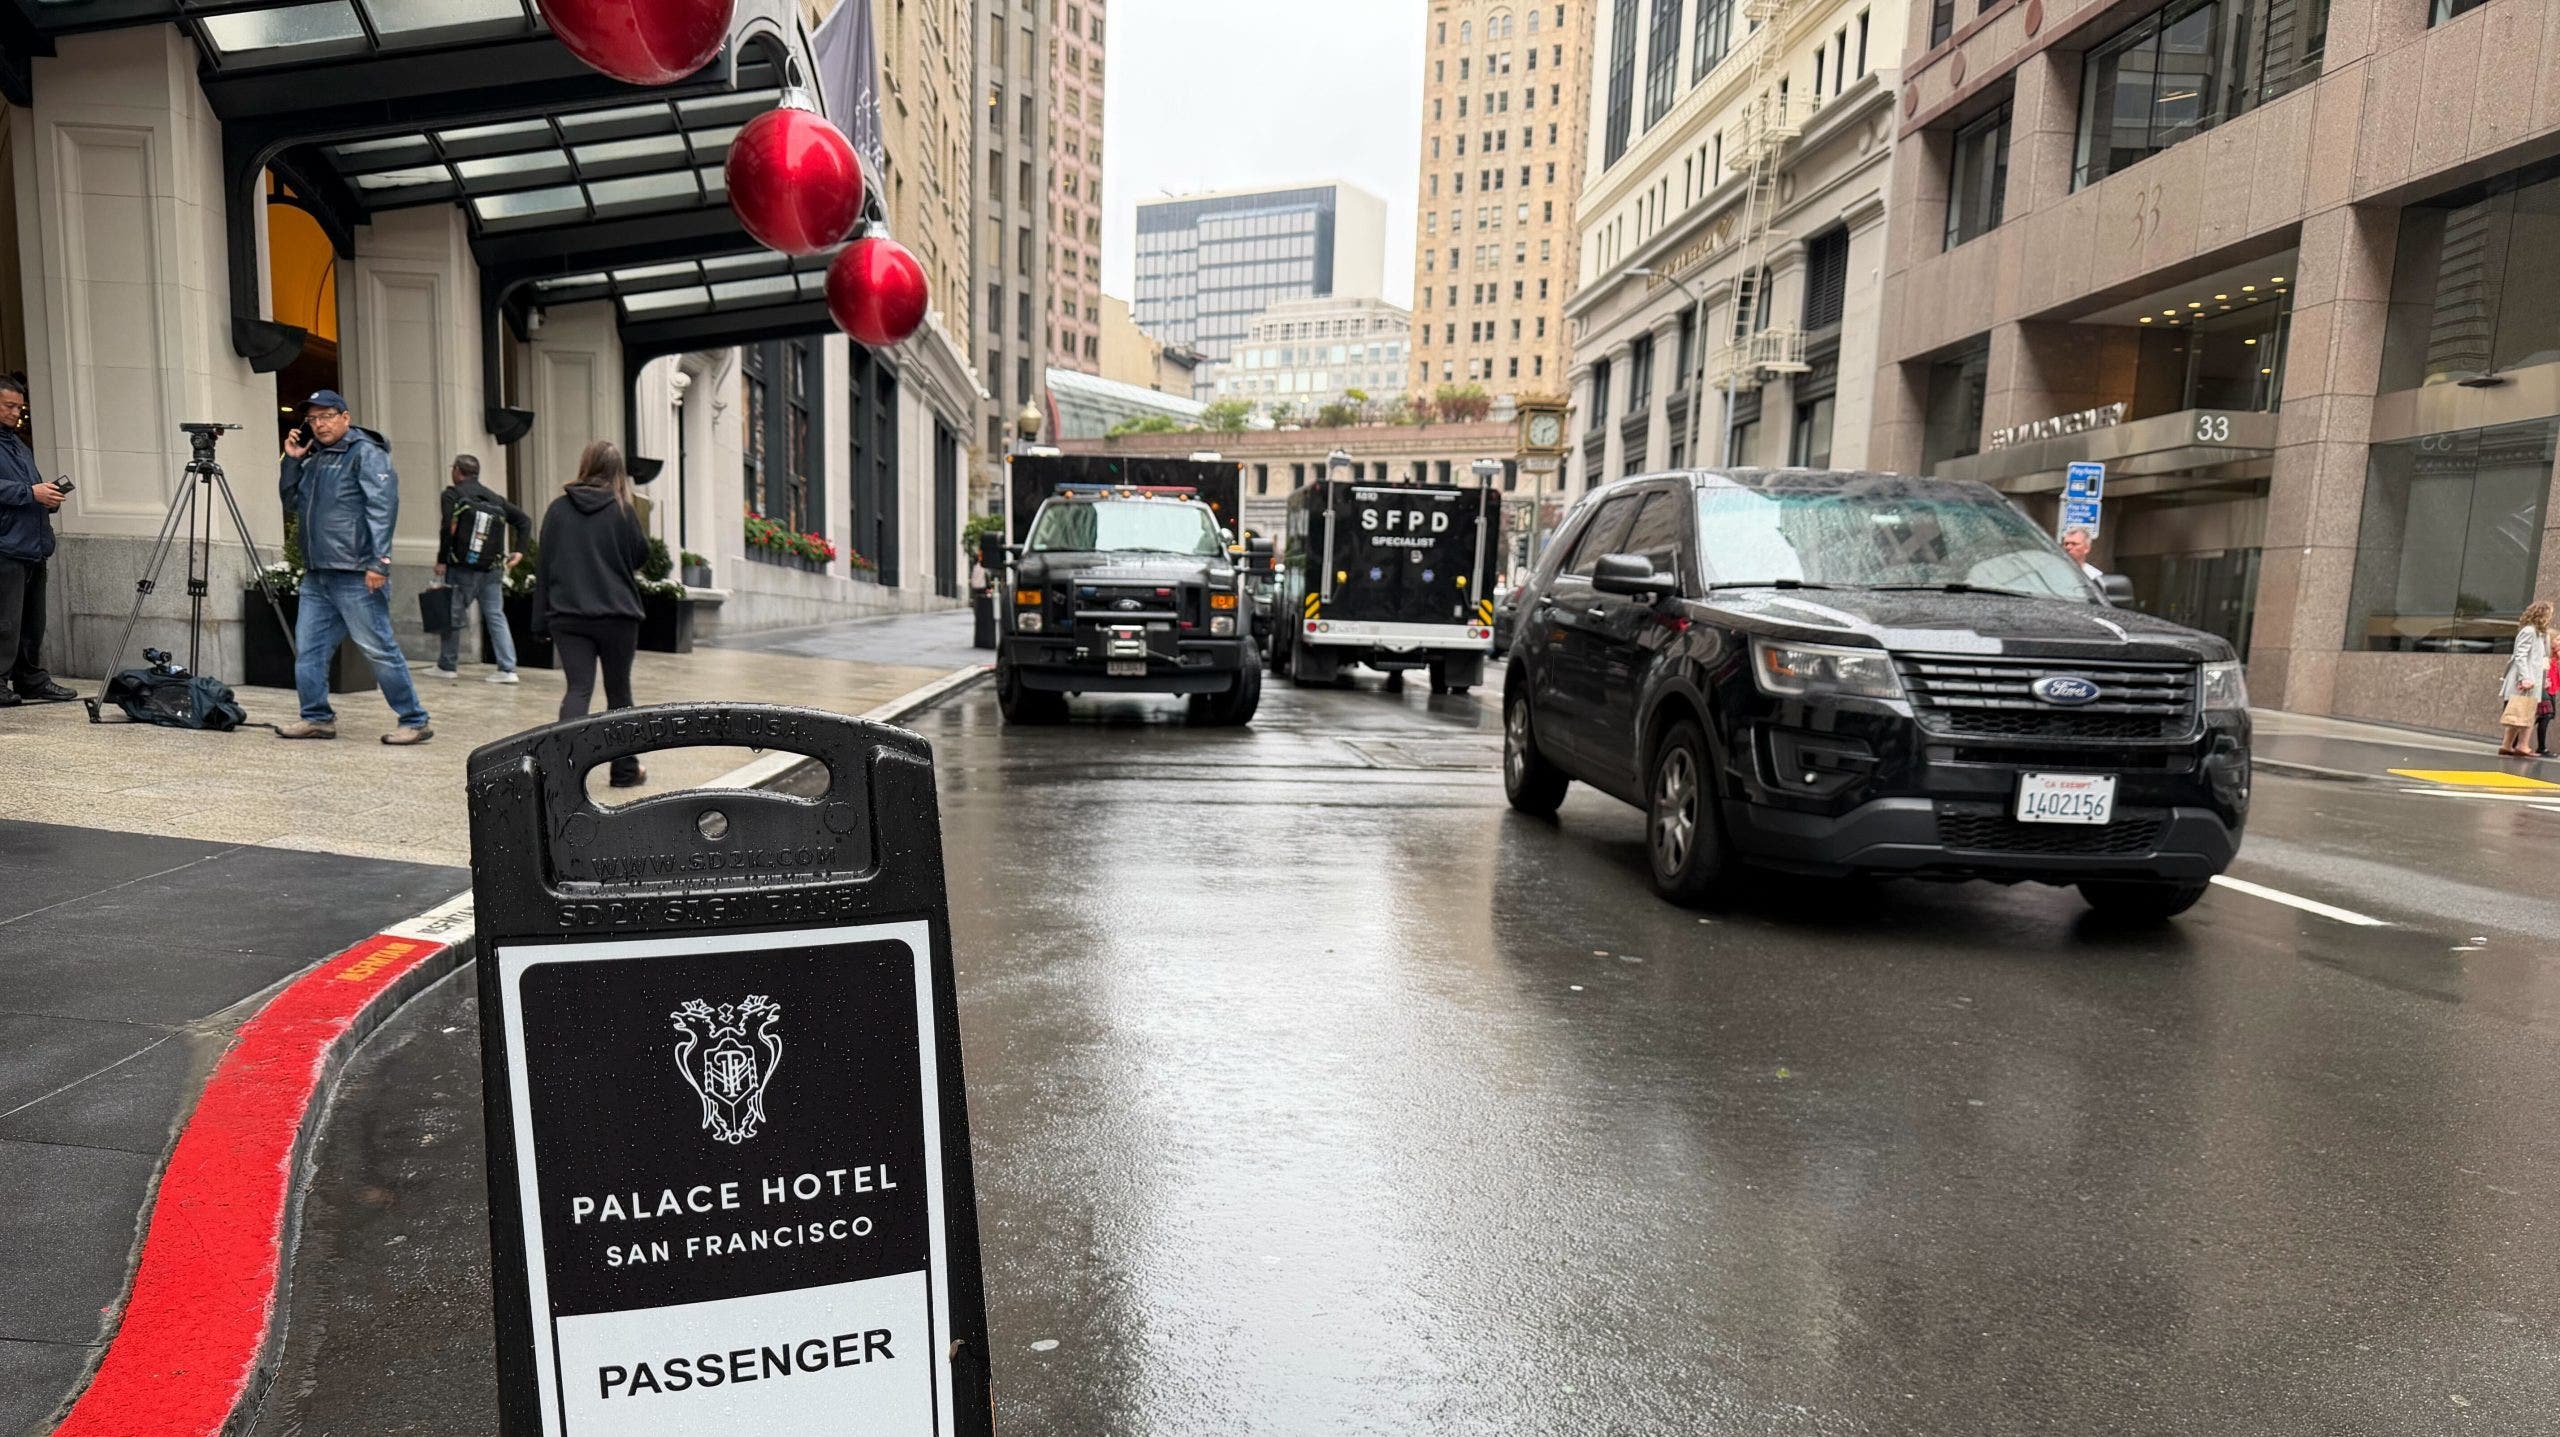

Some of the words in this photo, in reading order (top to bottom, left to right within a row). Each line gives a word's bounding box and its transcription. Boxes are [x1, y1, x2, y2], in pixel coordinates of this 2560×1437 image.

[2197, 415, 2229, 442] 33
[1361, 508, 1449, 532] SFPD
[1371, 536, 1436, 547] SPECIALIST
[2049, 680, 2088, 697] Ford
[603, 715, 689, 746] MADE
[746, 713, 800, 743] USA
[2044, 781, 2056, 789] CA
[2060, 781, 2092, 789] EXEMPT
[2025, 792, 2107, 816] 1402156
[573, 1181, 741, 1224] PALACE
[762, 1163, 898, 1205] HOTEL
[606, 1240, 670, 1267] SAN
[687, 1216, 874, 1259] FRANCISCO
[598, 1327, 896, 1400] PASSENGER
